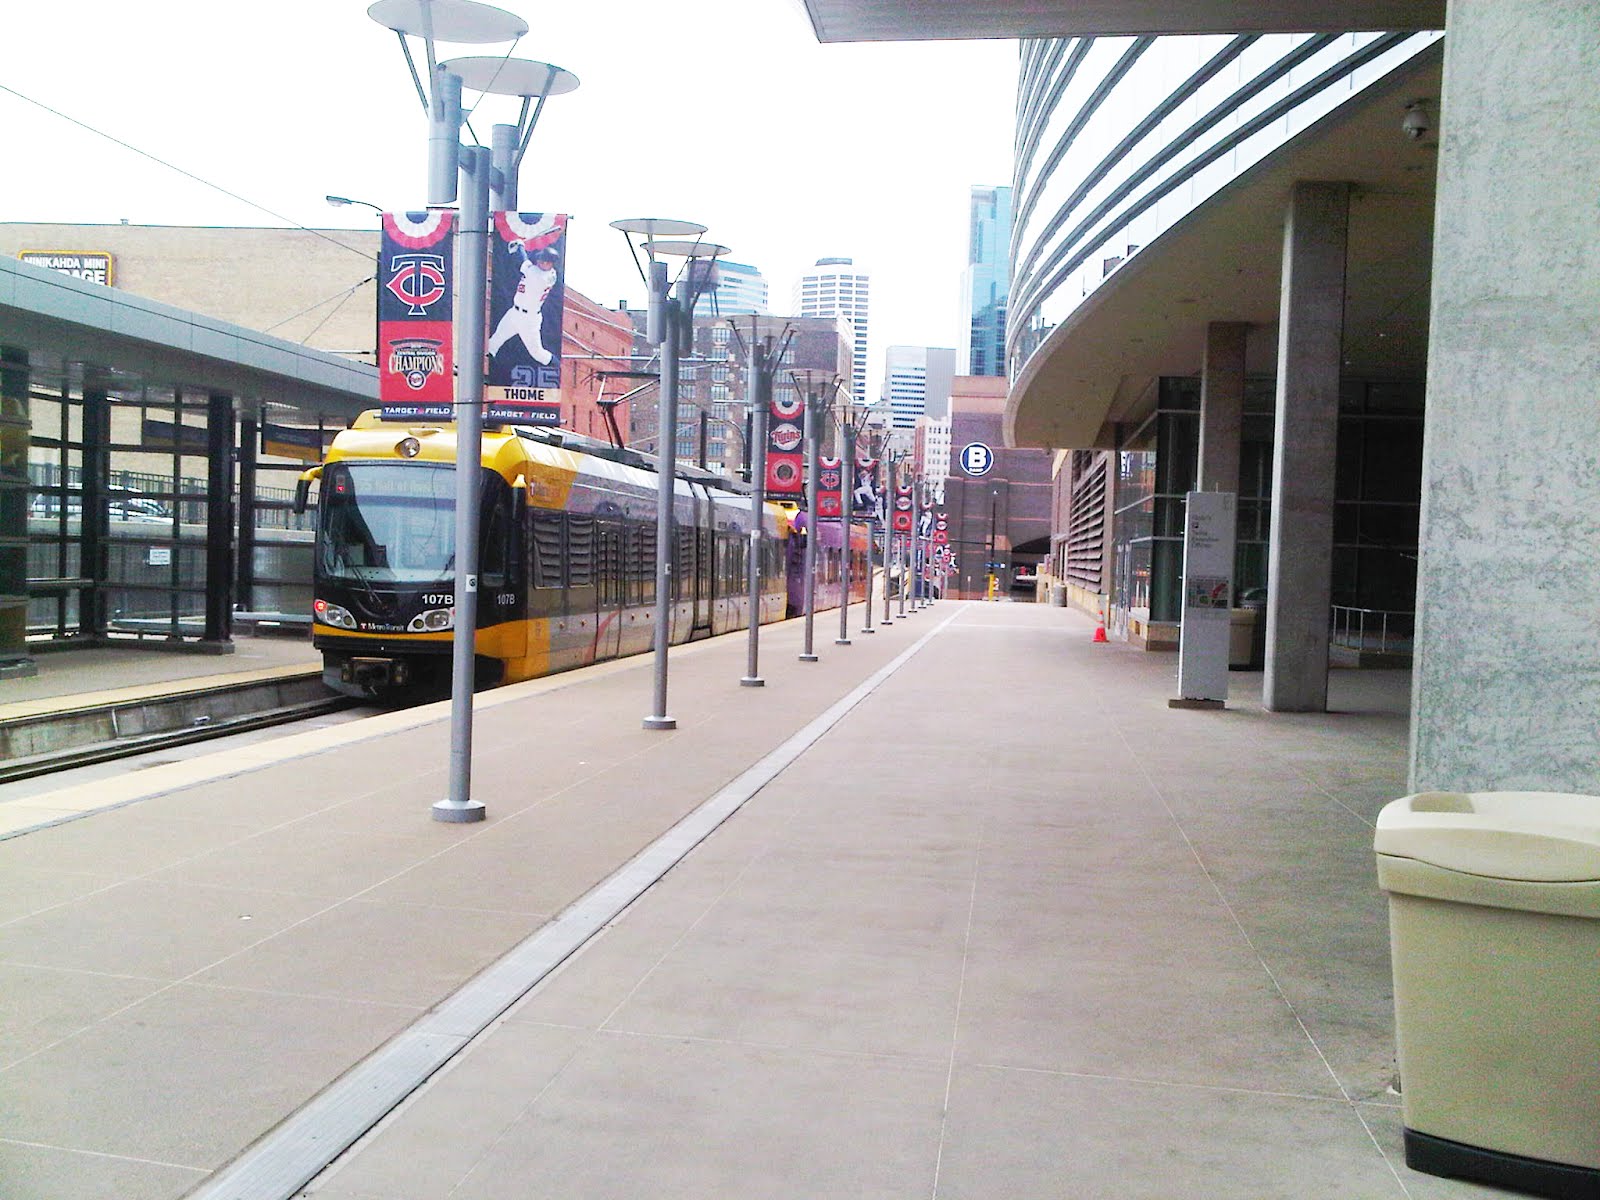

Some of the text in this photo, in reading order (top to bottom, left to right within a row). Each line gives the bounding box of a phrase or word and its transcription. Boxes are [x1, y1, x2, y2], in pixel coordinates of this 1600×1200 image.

[84, 258, 106, 269] MINI
[388, 353, 445, 375] CHAMPIONS
[503, 388, 545, 401] THOME
[384, 407, 450, 415] TARGET FIELD
[490, 410, 557, 420] TARGET FIELD
[770, 429, 801, 445] Twins
[968, 446, 987, 468] B
[422, 594, 454, 605] 107B
[497, 593, 515, 605] 107B
